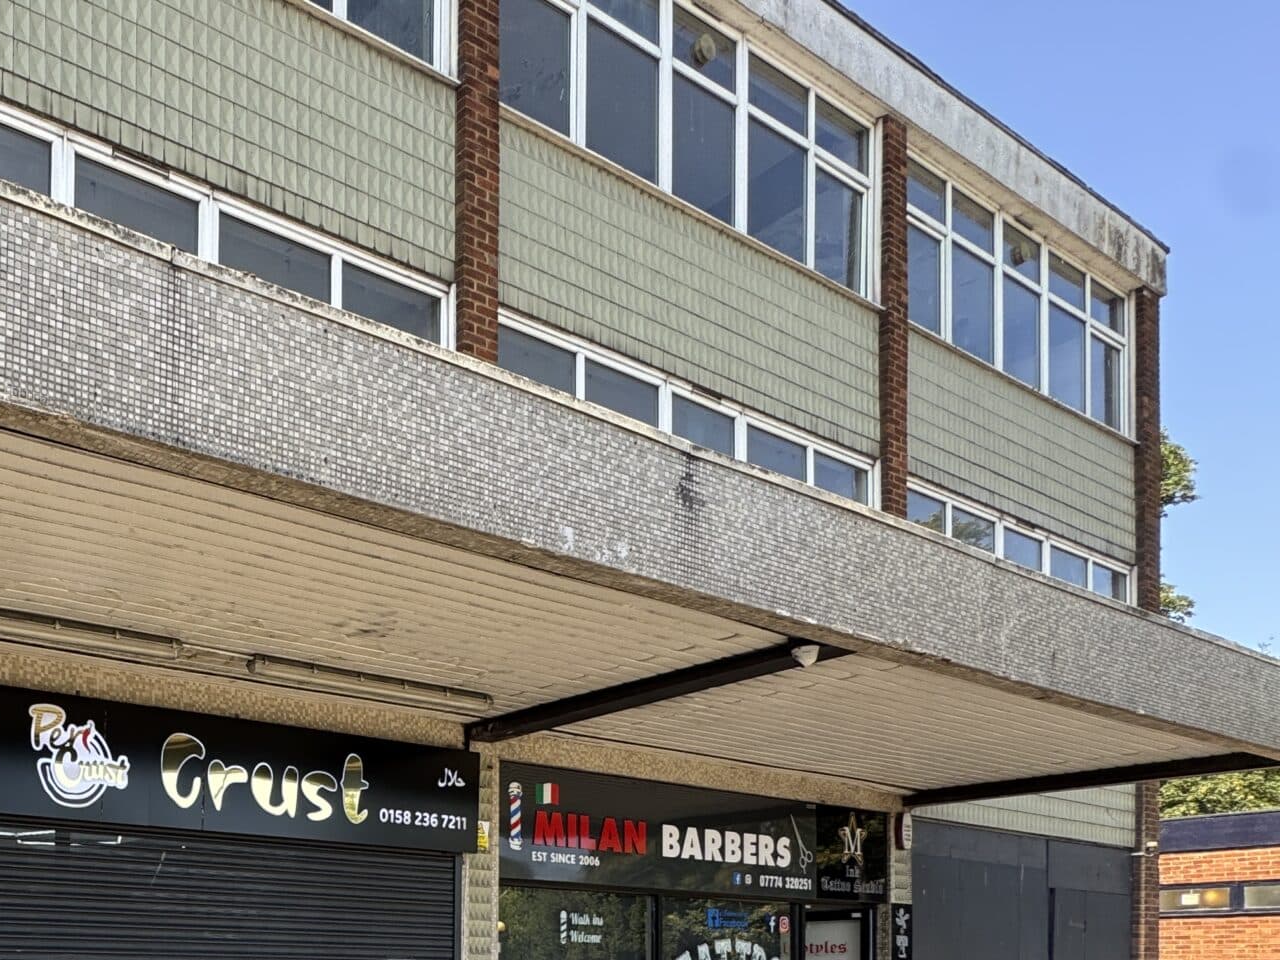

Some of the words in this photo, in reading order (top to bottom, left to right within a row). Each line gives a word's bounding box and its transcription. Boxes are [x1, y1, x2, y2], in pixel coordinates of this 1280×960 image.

[160, 732, 370, 824] Crust
[437, 767, 466, 788] حلال
[379, 807, 412, 825] 0158
[414, 811, 438, 828] 236
[441, 814, 467, 830] 7211
[532, 810, 647, 856] MILAN
[662, 823, 792, 868] BARBERS
[531, 851, 548, 862] EST
[550, 852, 576, 865] SINCE
[579, 854, 600, 867] 2006
